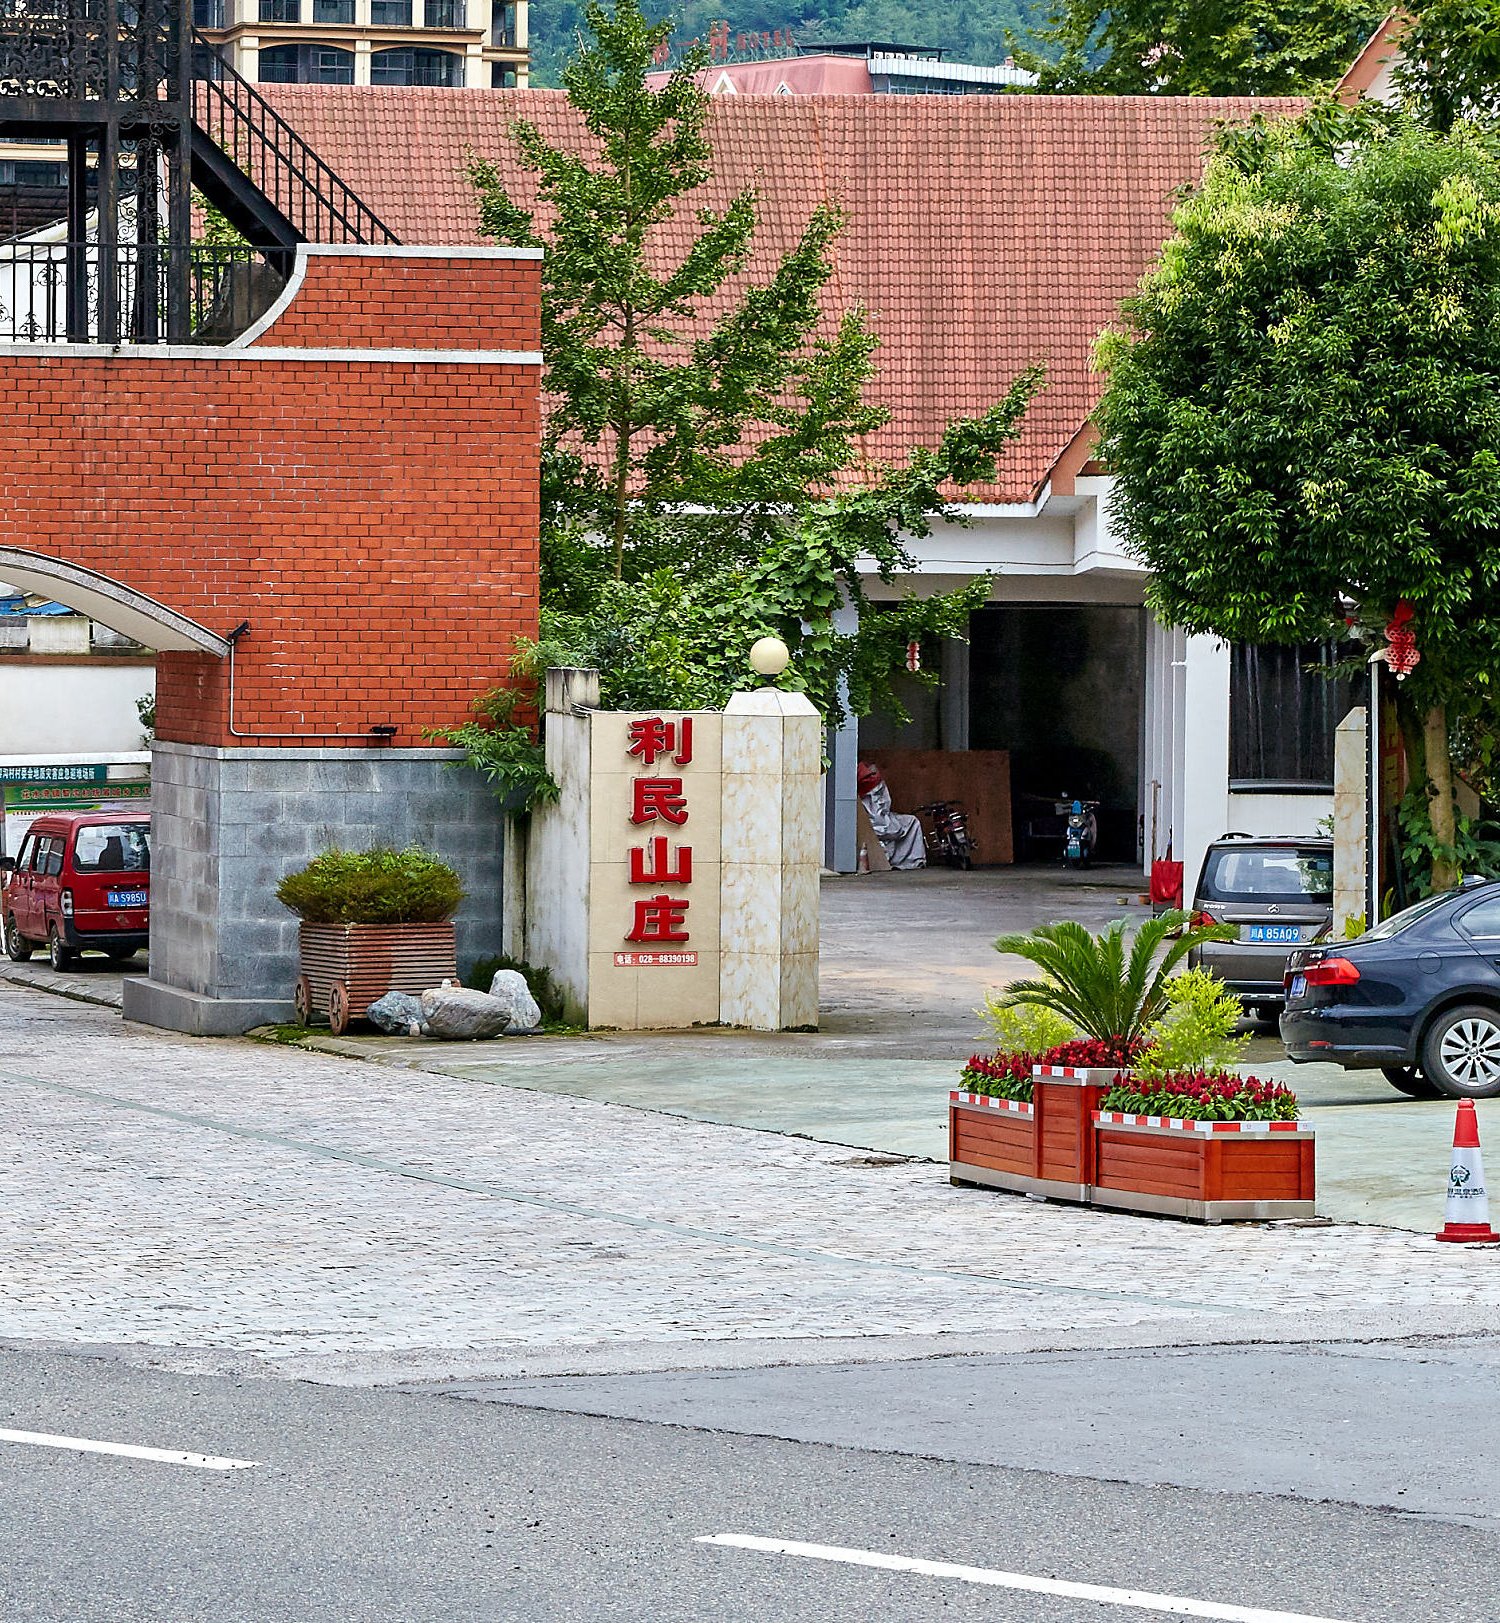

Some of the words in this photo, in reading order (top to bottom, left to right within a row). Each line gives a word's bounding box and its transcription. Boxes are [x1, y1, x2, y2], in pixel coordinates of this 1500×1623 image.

[738, 29, 795, 51] HOTEL
[626, 716, 693, 943] 利民山庄
